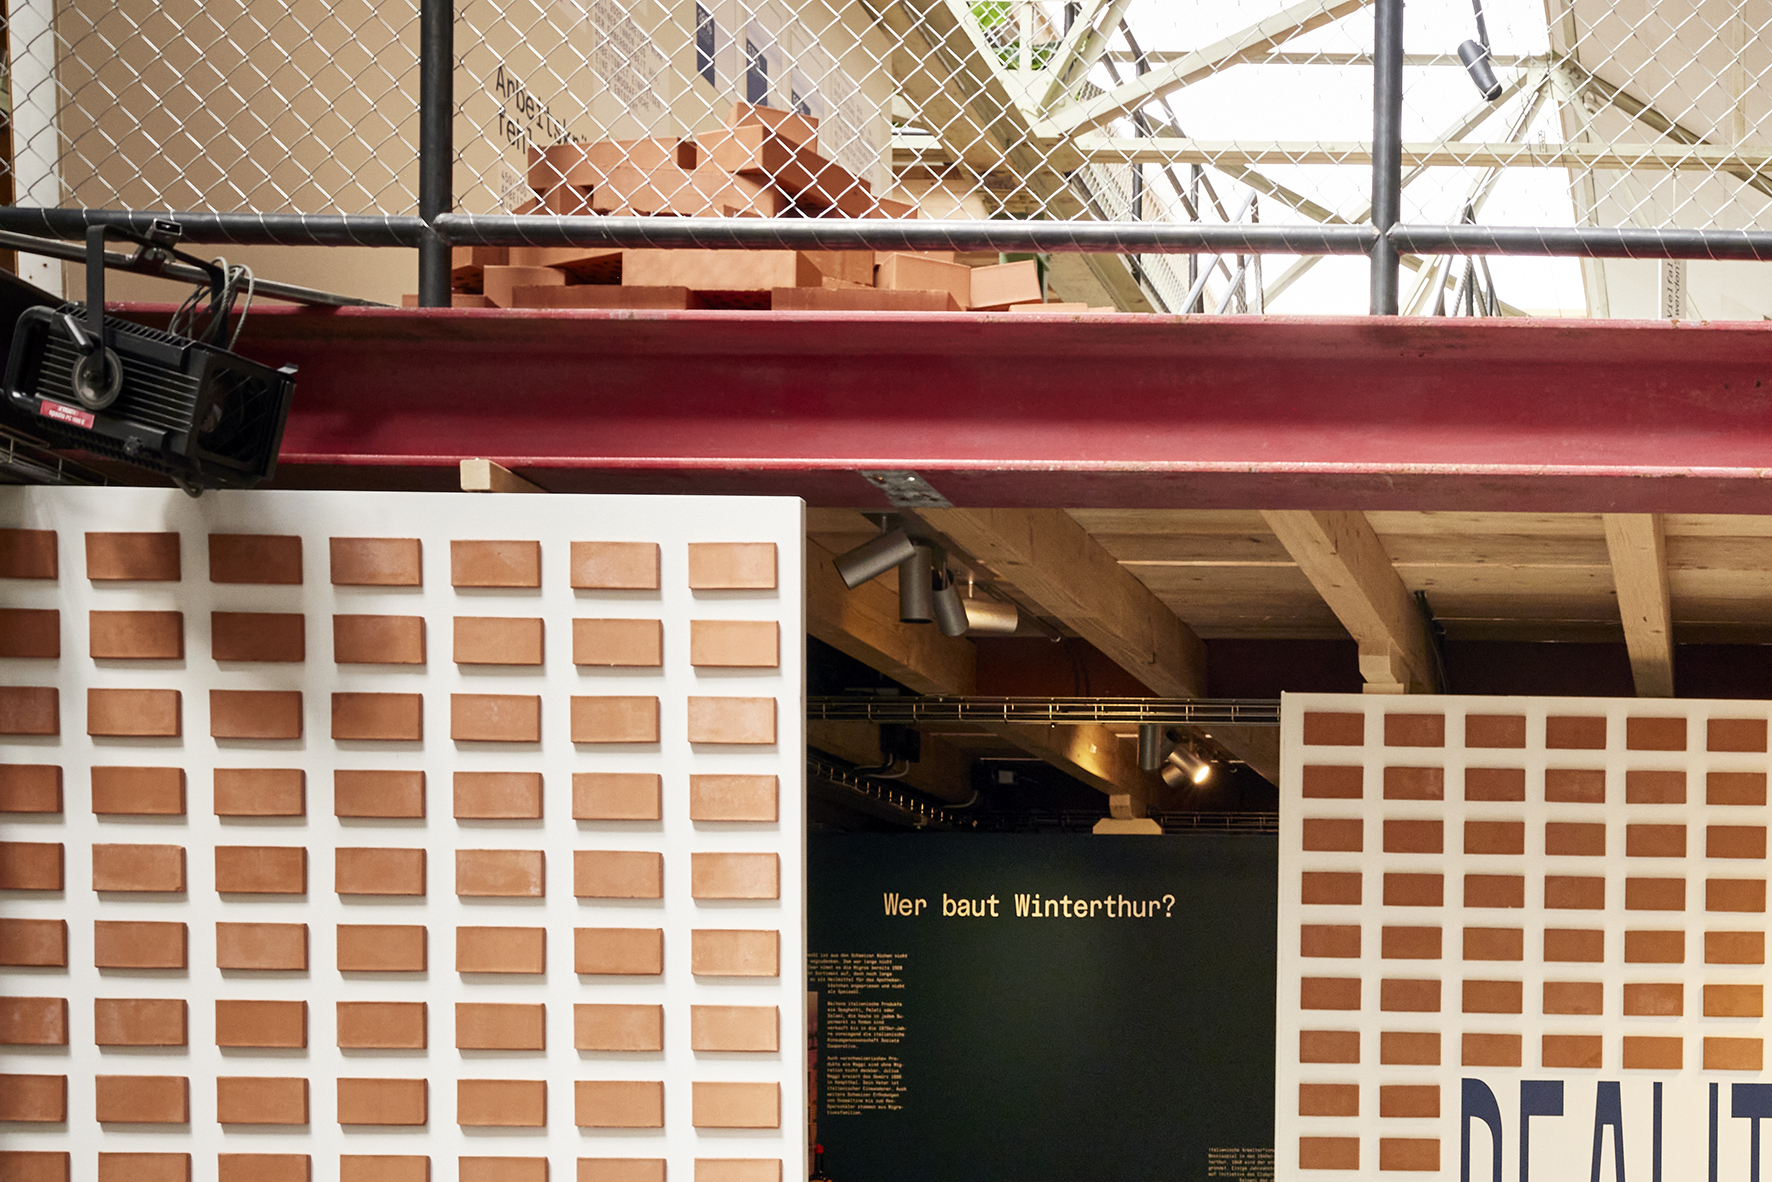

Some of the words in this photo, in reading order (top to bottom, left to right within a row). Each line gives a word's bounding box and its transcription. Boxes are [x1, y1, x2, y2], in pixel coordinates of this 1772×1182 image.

[883, 892, 928, 917] Wer
[942, 892, 1000, 918] baut
[1014, 893, 1176, 918] Winterthur?
